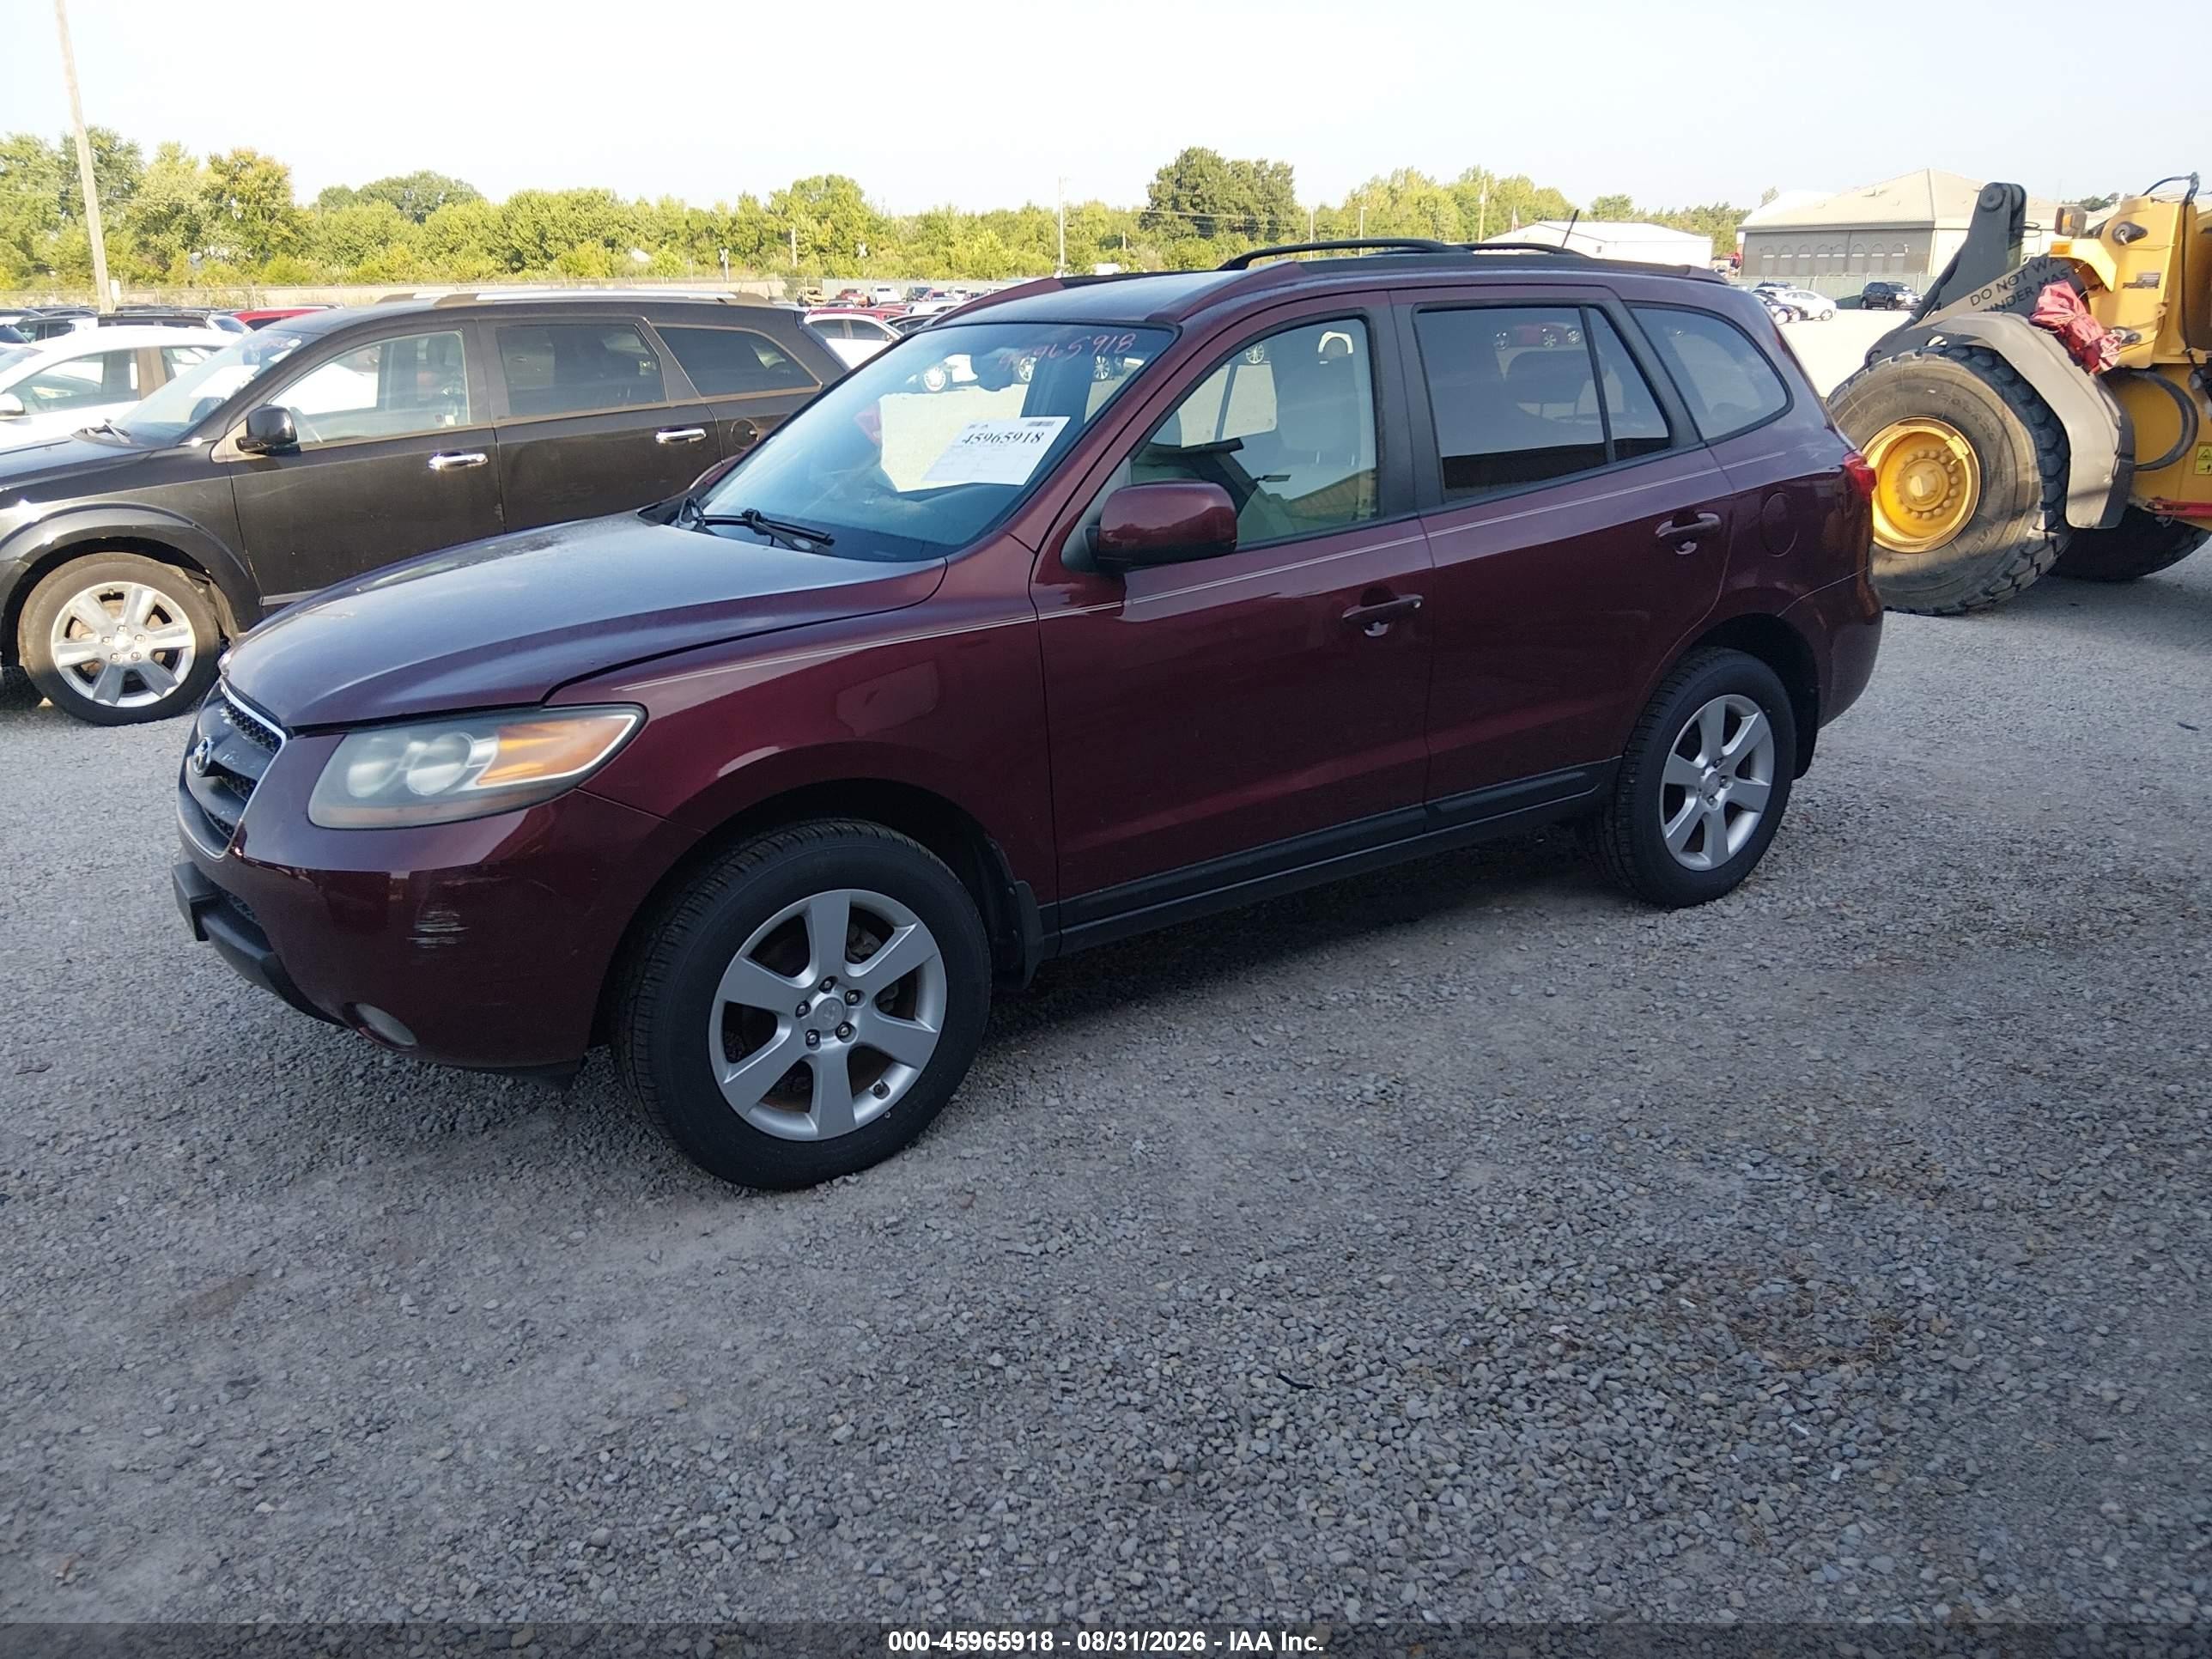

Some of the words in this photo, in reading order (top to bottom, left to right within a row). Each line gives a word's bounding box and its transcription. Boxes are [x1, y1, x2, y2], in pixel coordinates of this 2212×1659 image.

[1970, 289, 1992, 307] DO
[1996, 268, 2027, 292] NOT
[962, 431, 1044, 445] 45965918
